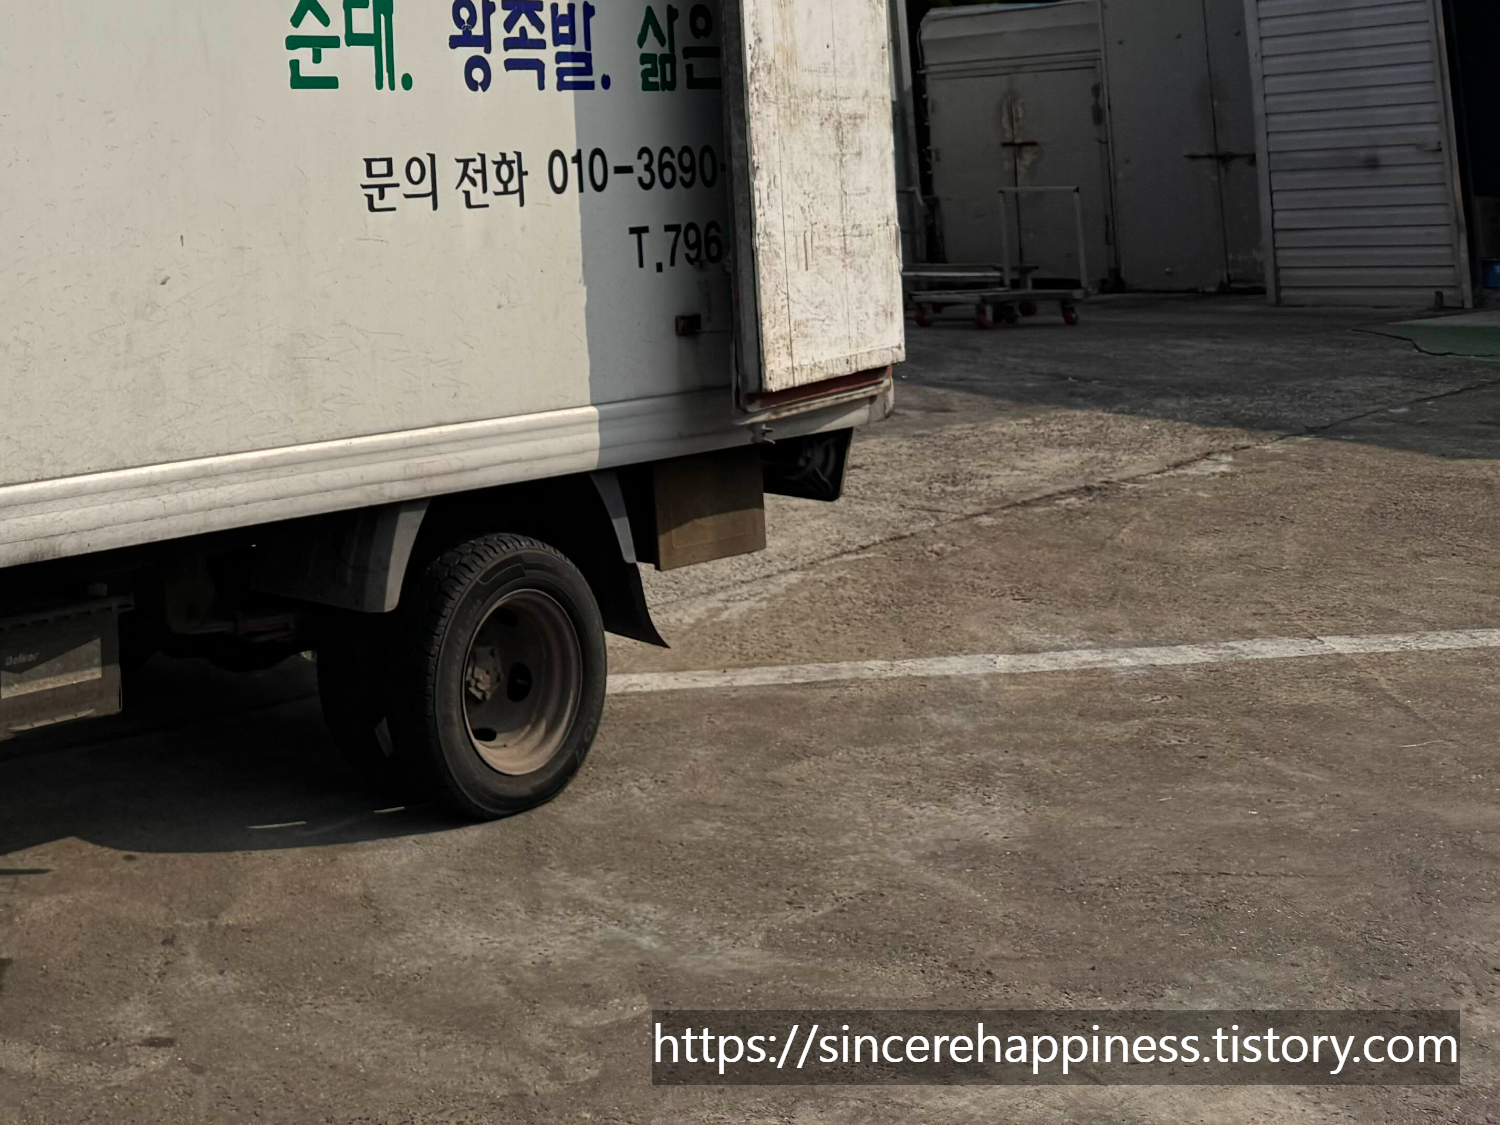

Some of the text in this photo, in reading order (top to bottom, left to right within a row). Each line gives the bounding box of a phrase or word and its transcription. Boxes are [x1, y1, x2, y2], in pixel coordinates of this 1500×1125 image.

[637, 3, 722, 92] 삶은
[360, 144, 727, 213] 문의 전화 010-3690
